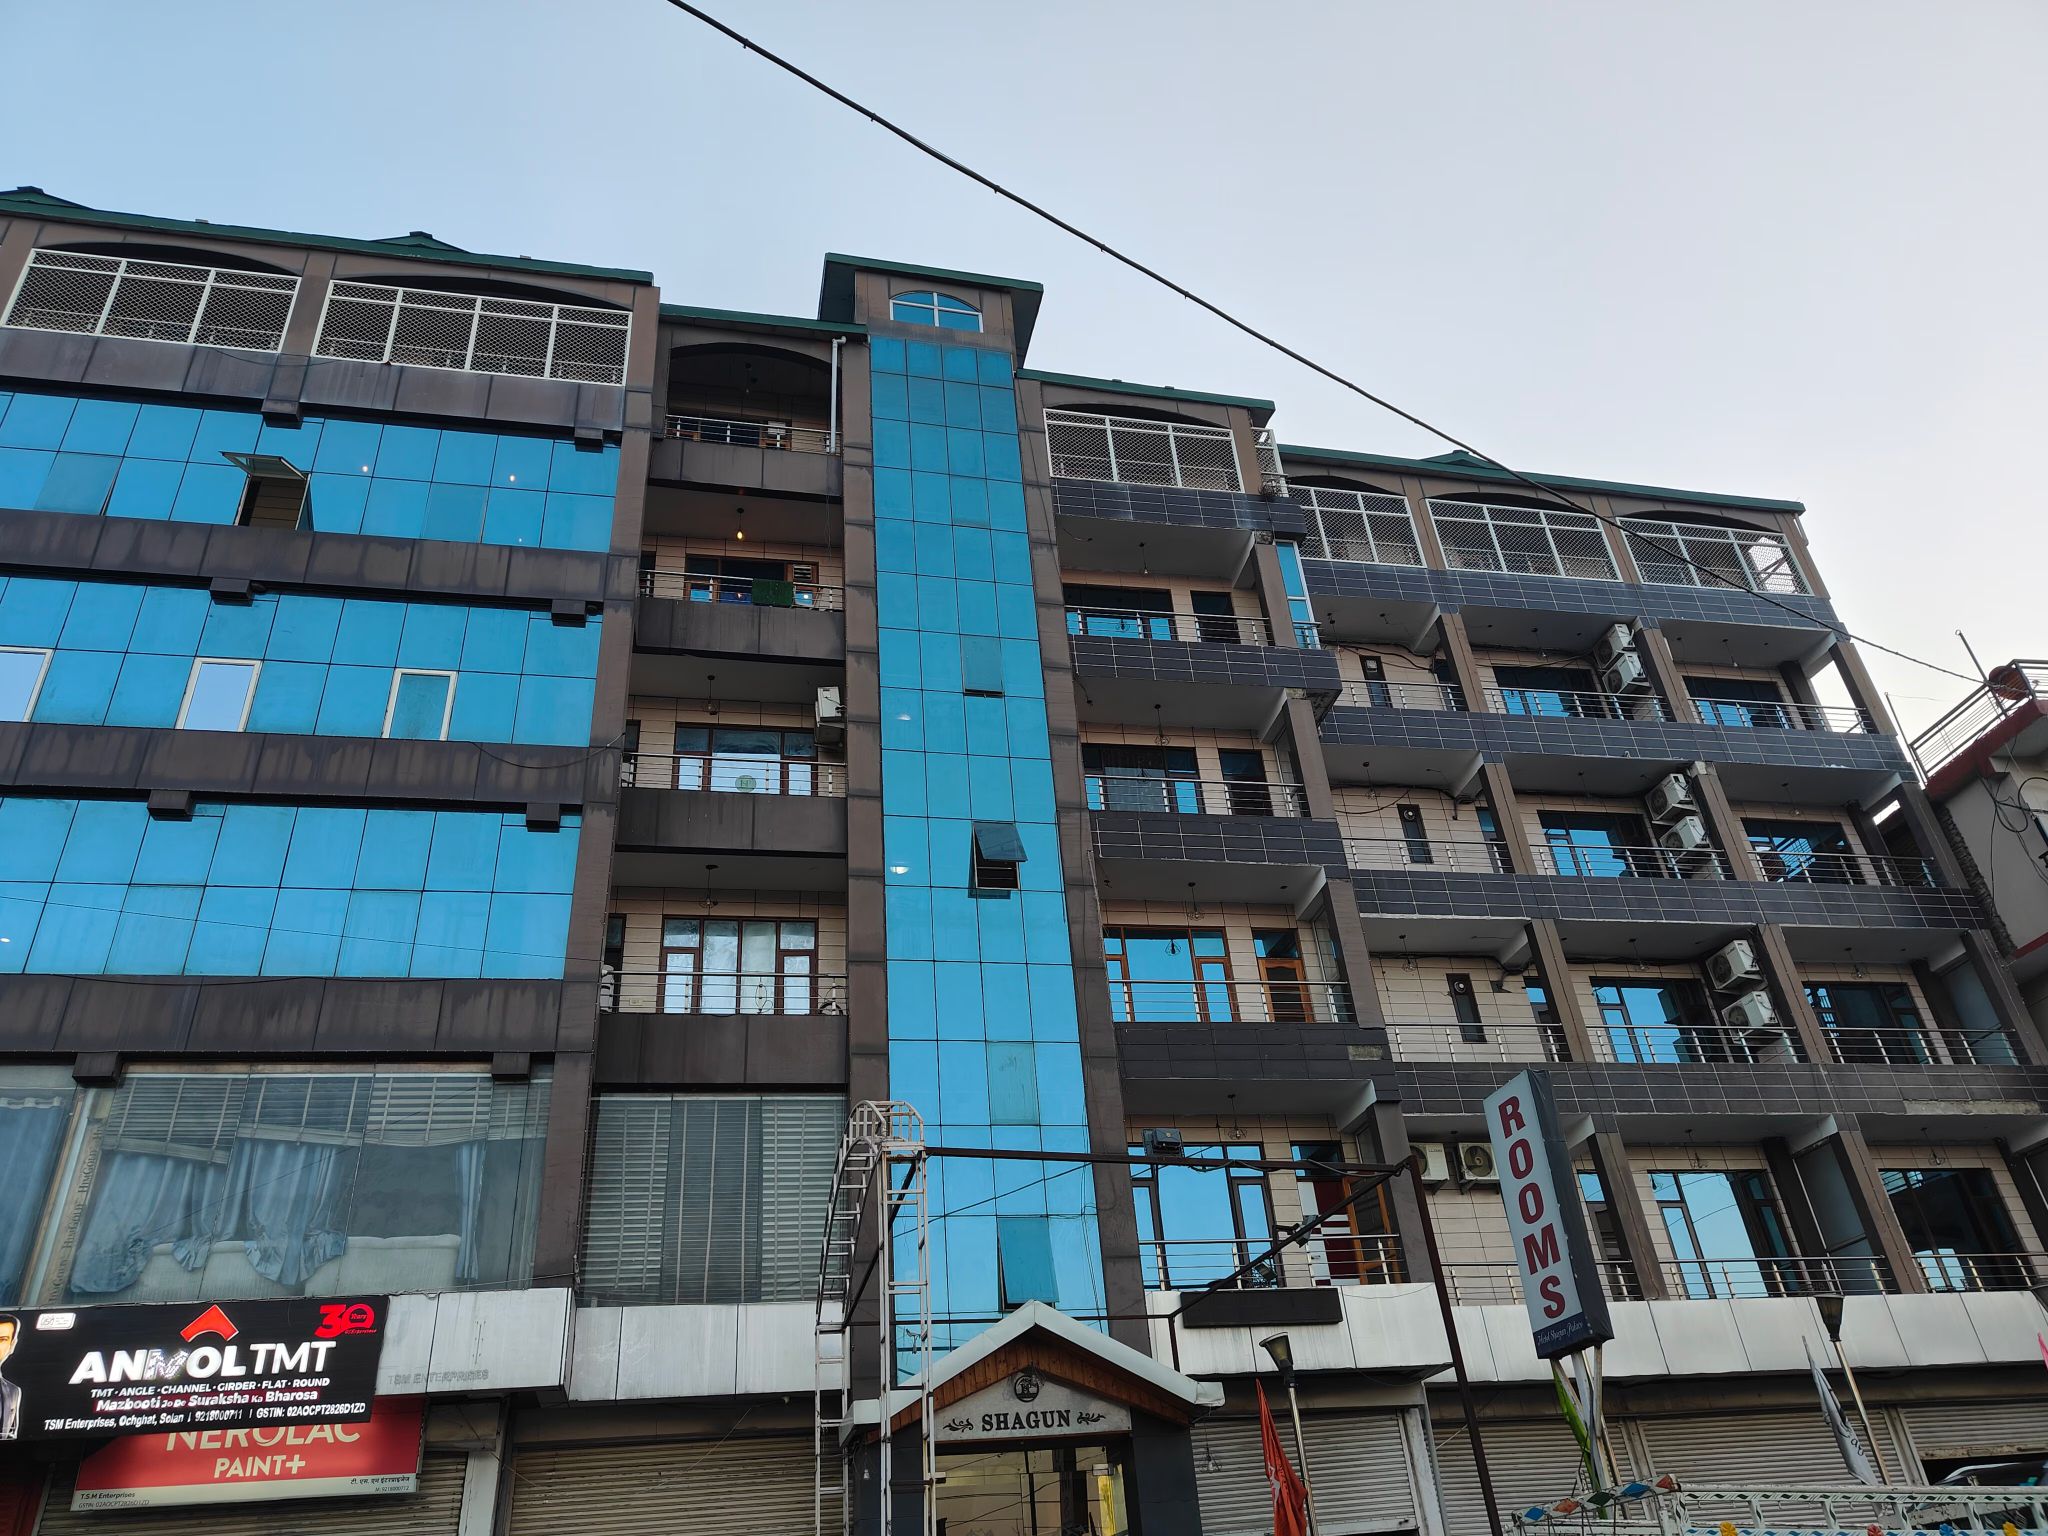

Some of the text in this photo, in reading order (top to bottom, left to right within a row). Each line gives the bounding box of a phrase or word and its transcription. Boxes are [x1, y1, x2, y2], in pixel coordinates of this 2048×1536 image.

[1498, 1095, 1566, 1319] ROOMS
[314, 1304, 375, 1338] 30
[68, 1341, 337, 1384] ANMOL TMT
[91, 1378, 330, 1398] TMT ANGLE CHANNEL GIRDER FLAT ROUND
[96, 1396, 161, 1411] Mazbooti
[188, 1392, 250, 1406] Suraksha
[251, 1395, 263, 1403] Ka
[265, 1390, 318, 1403] Bharosa
[44, 1418, 63, 1430] TSM
[65, 1416, 117, 1430] Enterprises,
[119, 1414, 158, 1427] Ochghat,
[159, 1413, 184, 1424] Solan
[256, 1406, 285, 1418] GSTIN:
[981, 1409, 1071, 1432] SHAGUN
[214, 1454, 306, 1479] PAINT+
[99, 1491, 135, 1499] Enterprises
